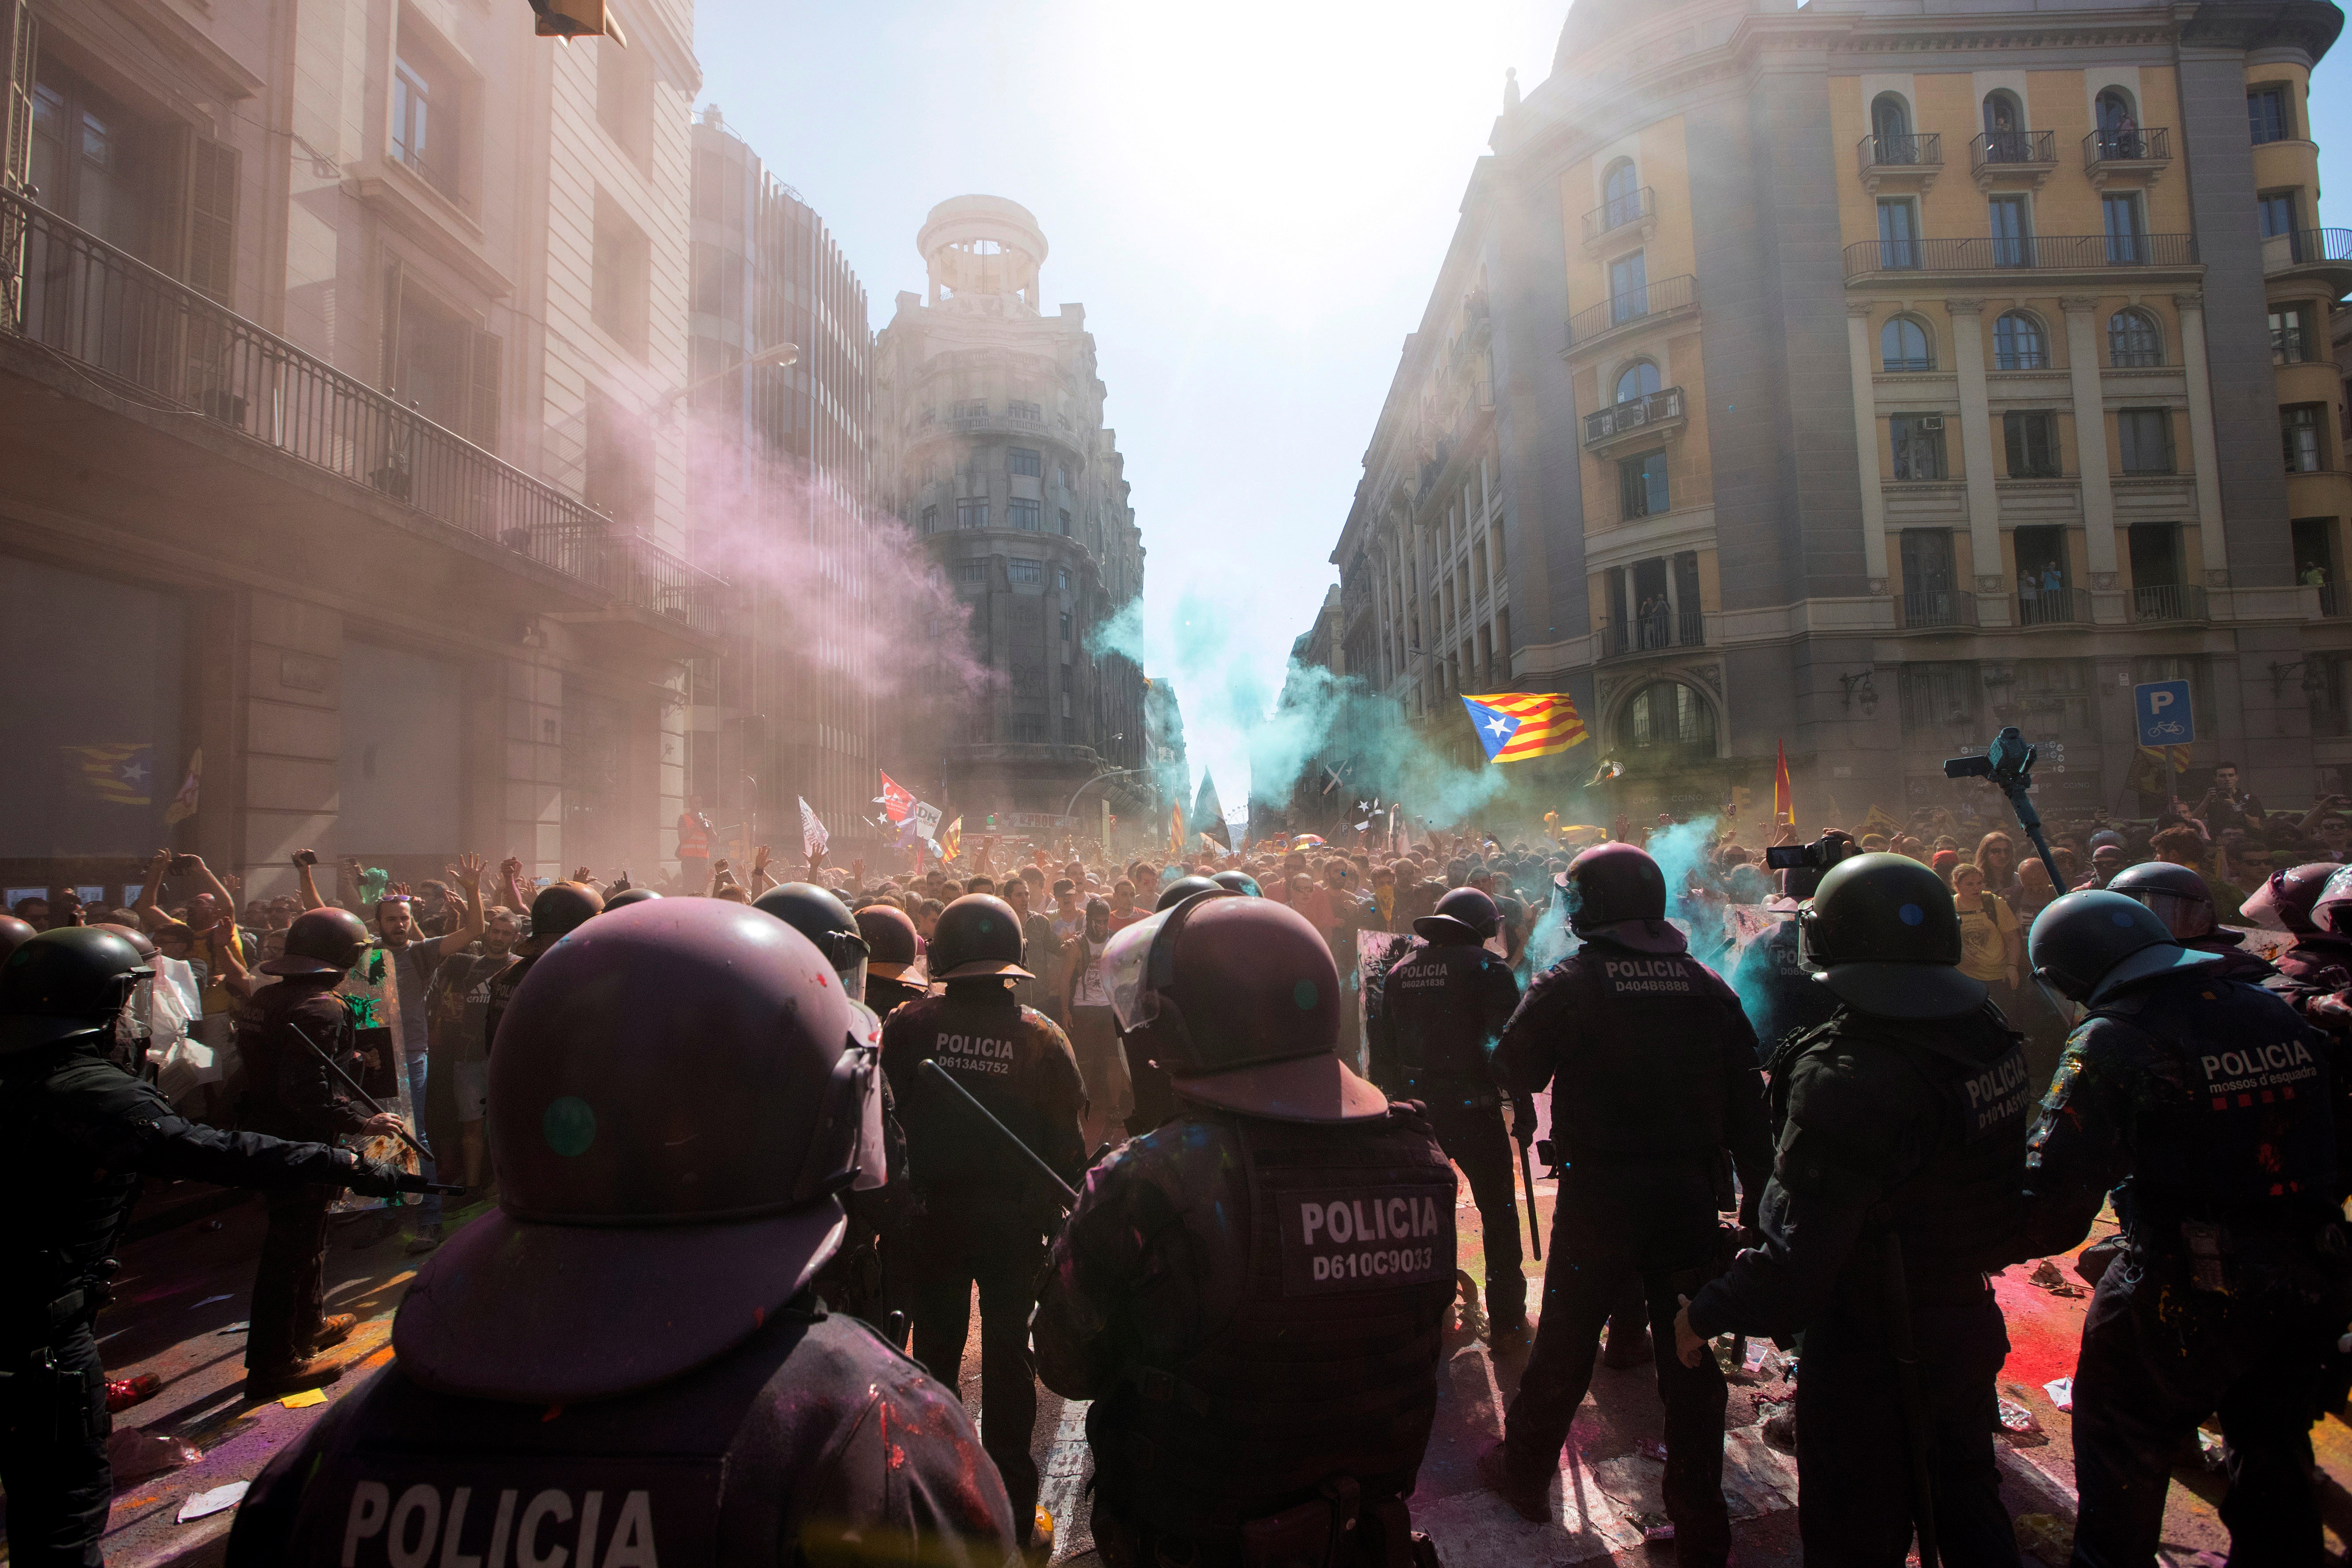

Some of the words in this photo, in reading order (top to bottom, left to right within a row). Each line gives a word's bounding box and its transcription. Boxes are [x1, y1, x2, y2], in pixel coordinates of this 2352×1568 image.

[2150, 691, 2174, 714] P
[917, 806, 939, 823] DR
[961, 837, 999, 845] Perióo
[1400, 963, 1448, 979] POLICIA
[1605, 960, 1690, 978] POLICIA
[1402, 978, 1445, 988] D602A1836
[1615, 980, 1690, 992] D404B6888
[936, 1032, 1014, 1060] POLICIA
[938, 1055, 1009, 1074] D613A5752
[2201, 1039, 2313, 1080] POLICIA
[1965, 1054, 2027, 1109] POLICIA
[2209, 1076, 2257, 1094] mossos
[1301, 1196, 1438, 1246] POLICIA
[1313, 1247, 1433, 1281] D610C9033
[341, 1480, 659, 1568] POLICIA
